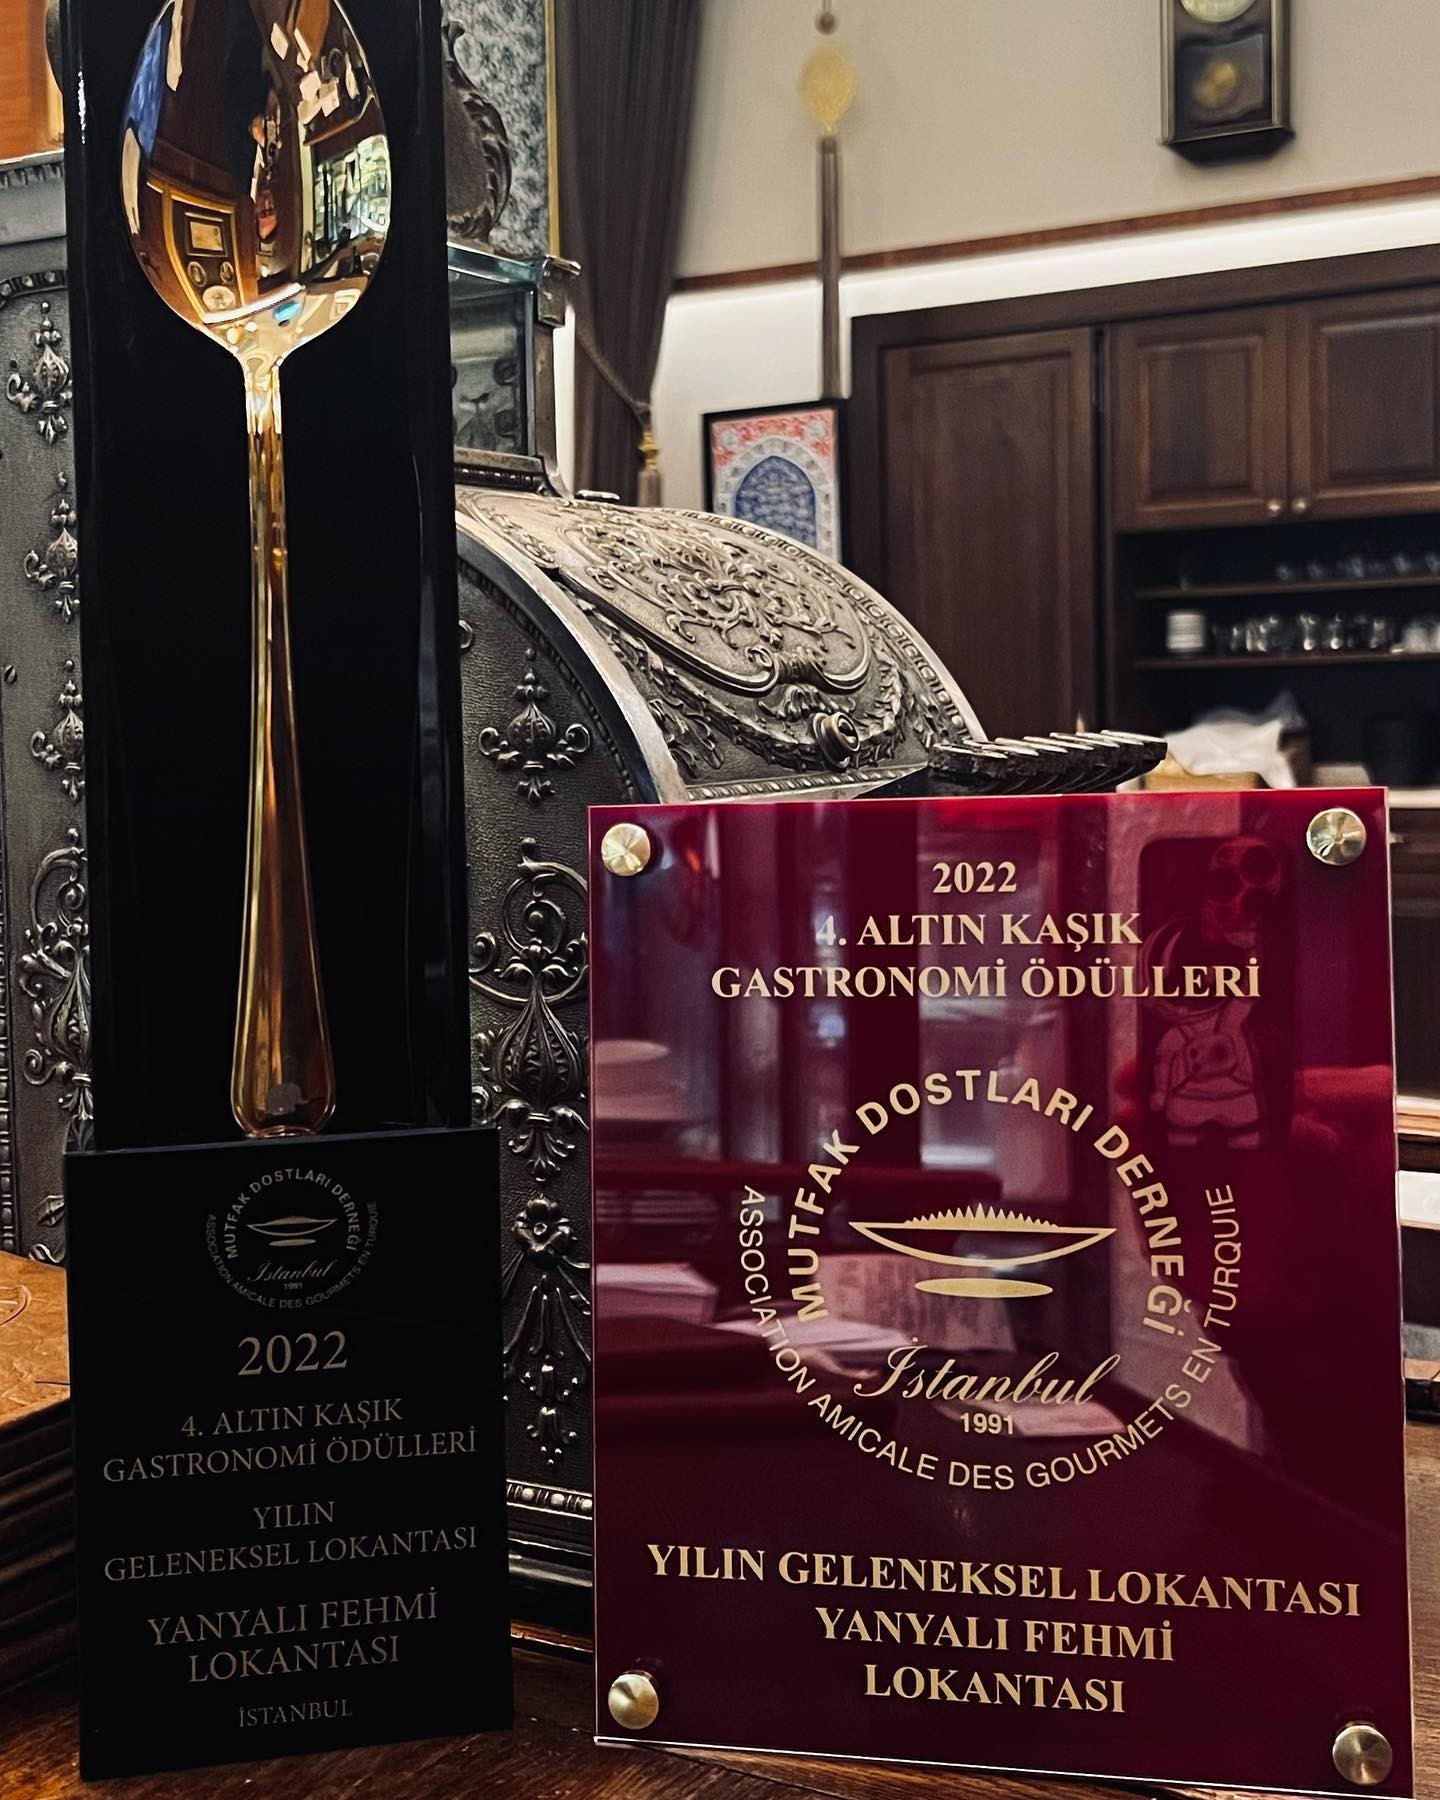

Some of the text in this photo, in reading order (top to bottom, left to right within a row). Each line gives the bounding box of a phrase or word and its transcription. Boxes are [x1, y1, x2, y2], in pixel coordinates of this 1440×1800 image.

[932, 861, 1017, 894] 2022
[815, 911, 1143, 954] 4. ALTIN KAŞIK
[711, 956, 1261, 998] GASTRONOMİ ÖDÜLLERİ
[223, 1192, 251, 1260] MUTFAK
[249, 1168, 331, 1194] DOSTLARI
[788, 1129, 860, 1322] MUTFAK
[856, 1069, 1094, 1135] DOSTLARI
[206, 1213, 232, 1285] ASSOCIATION
[231, 1280, 277, 1309] AMICALE
[279, 1298, 303, 1309] DES
[305, 1266, 362, 1307] GOURMETS
[357, 1249, 371, 1266] EN
[237, 1330, 348, 1377] 2022
[739, 1184, 1242, 1490] ASSOCIATION AMICALE DES GOURMETS EN TURQUIE
[853, 1336, 1121, 1406] İstanbul
[181, 1398, 403, 1438] 4. ALTIN KAŞIK
[959, 1413, 1014, 1436] 1991
[103, 1425, 477, 1483] GASTRONOMİ ÖDÜLLERİ
[253, 1501, 336, 1530] YILIN
[104, 1526, 477, 1582] GELENEKSEL LOKANTASI
[646, 1543, 1361, 1617] YILIN GELENEKSEL LOKANTASI
[147, 1586, 438, 1648] YANYALI FEHMİ
[815, 1607, 1175, 1662] YANYALI FEHMİ
[188, 1635, 401, 1683] LOKANTASI
[238, 1699, 353, 1728] İSTANBUL
[863, 1663, 1127, 1714] LOKANTASI
